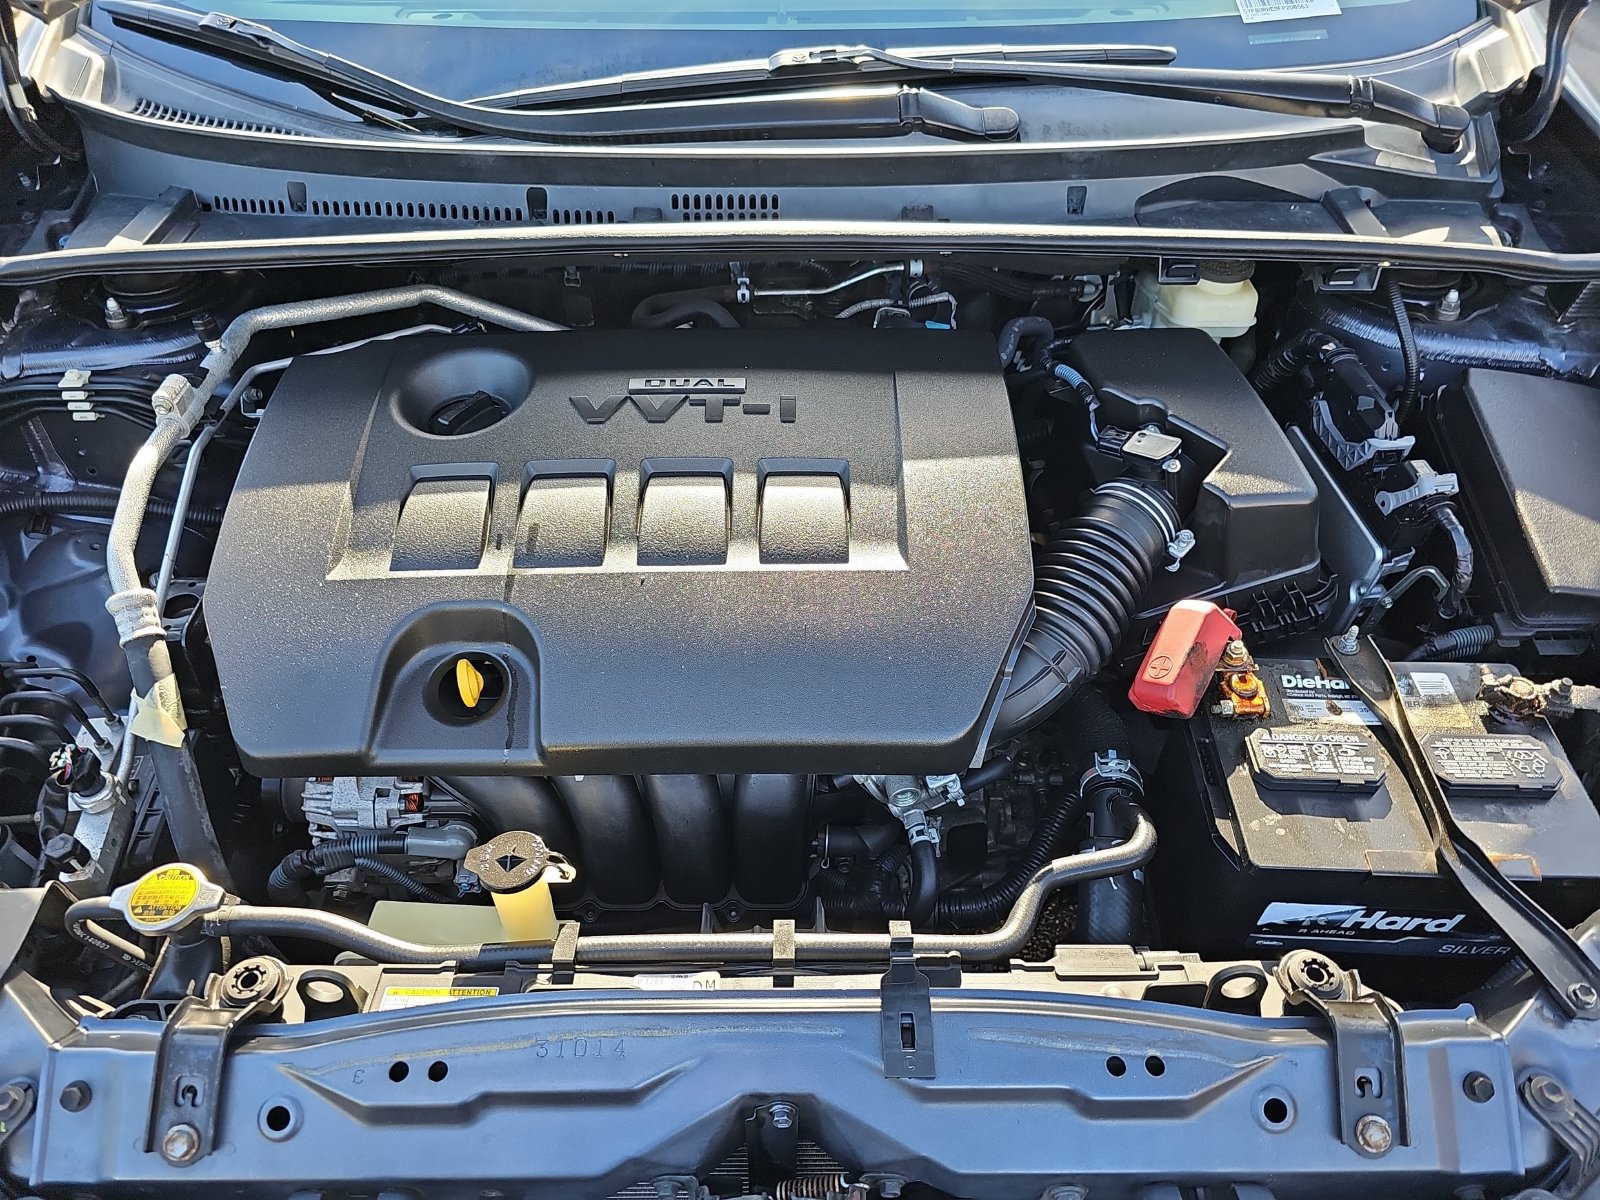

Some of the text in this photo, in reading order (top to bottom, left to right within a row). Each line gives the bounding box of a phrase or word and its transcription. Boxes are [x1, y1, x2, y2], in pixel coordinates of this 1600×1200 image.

[644, 378, 736, 388] DUAL
[1271, 733, 1312, 741] DANGER
[1438, 944, 1512, 955] SILVER
[536, 1037, 626, 1058] 31014
